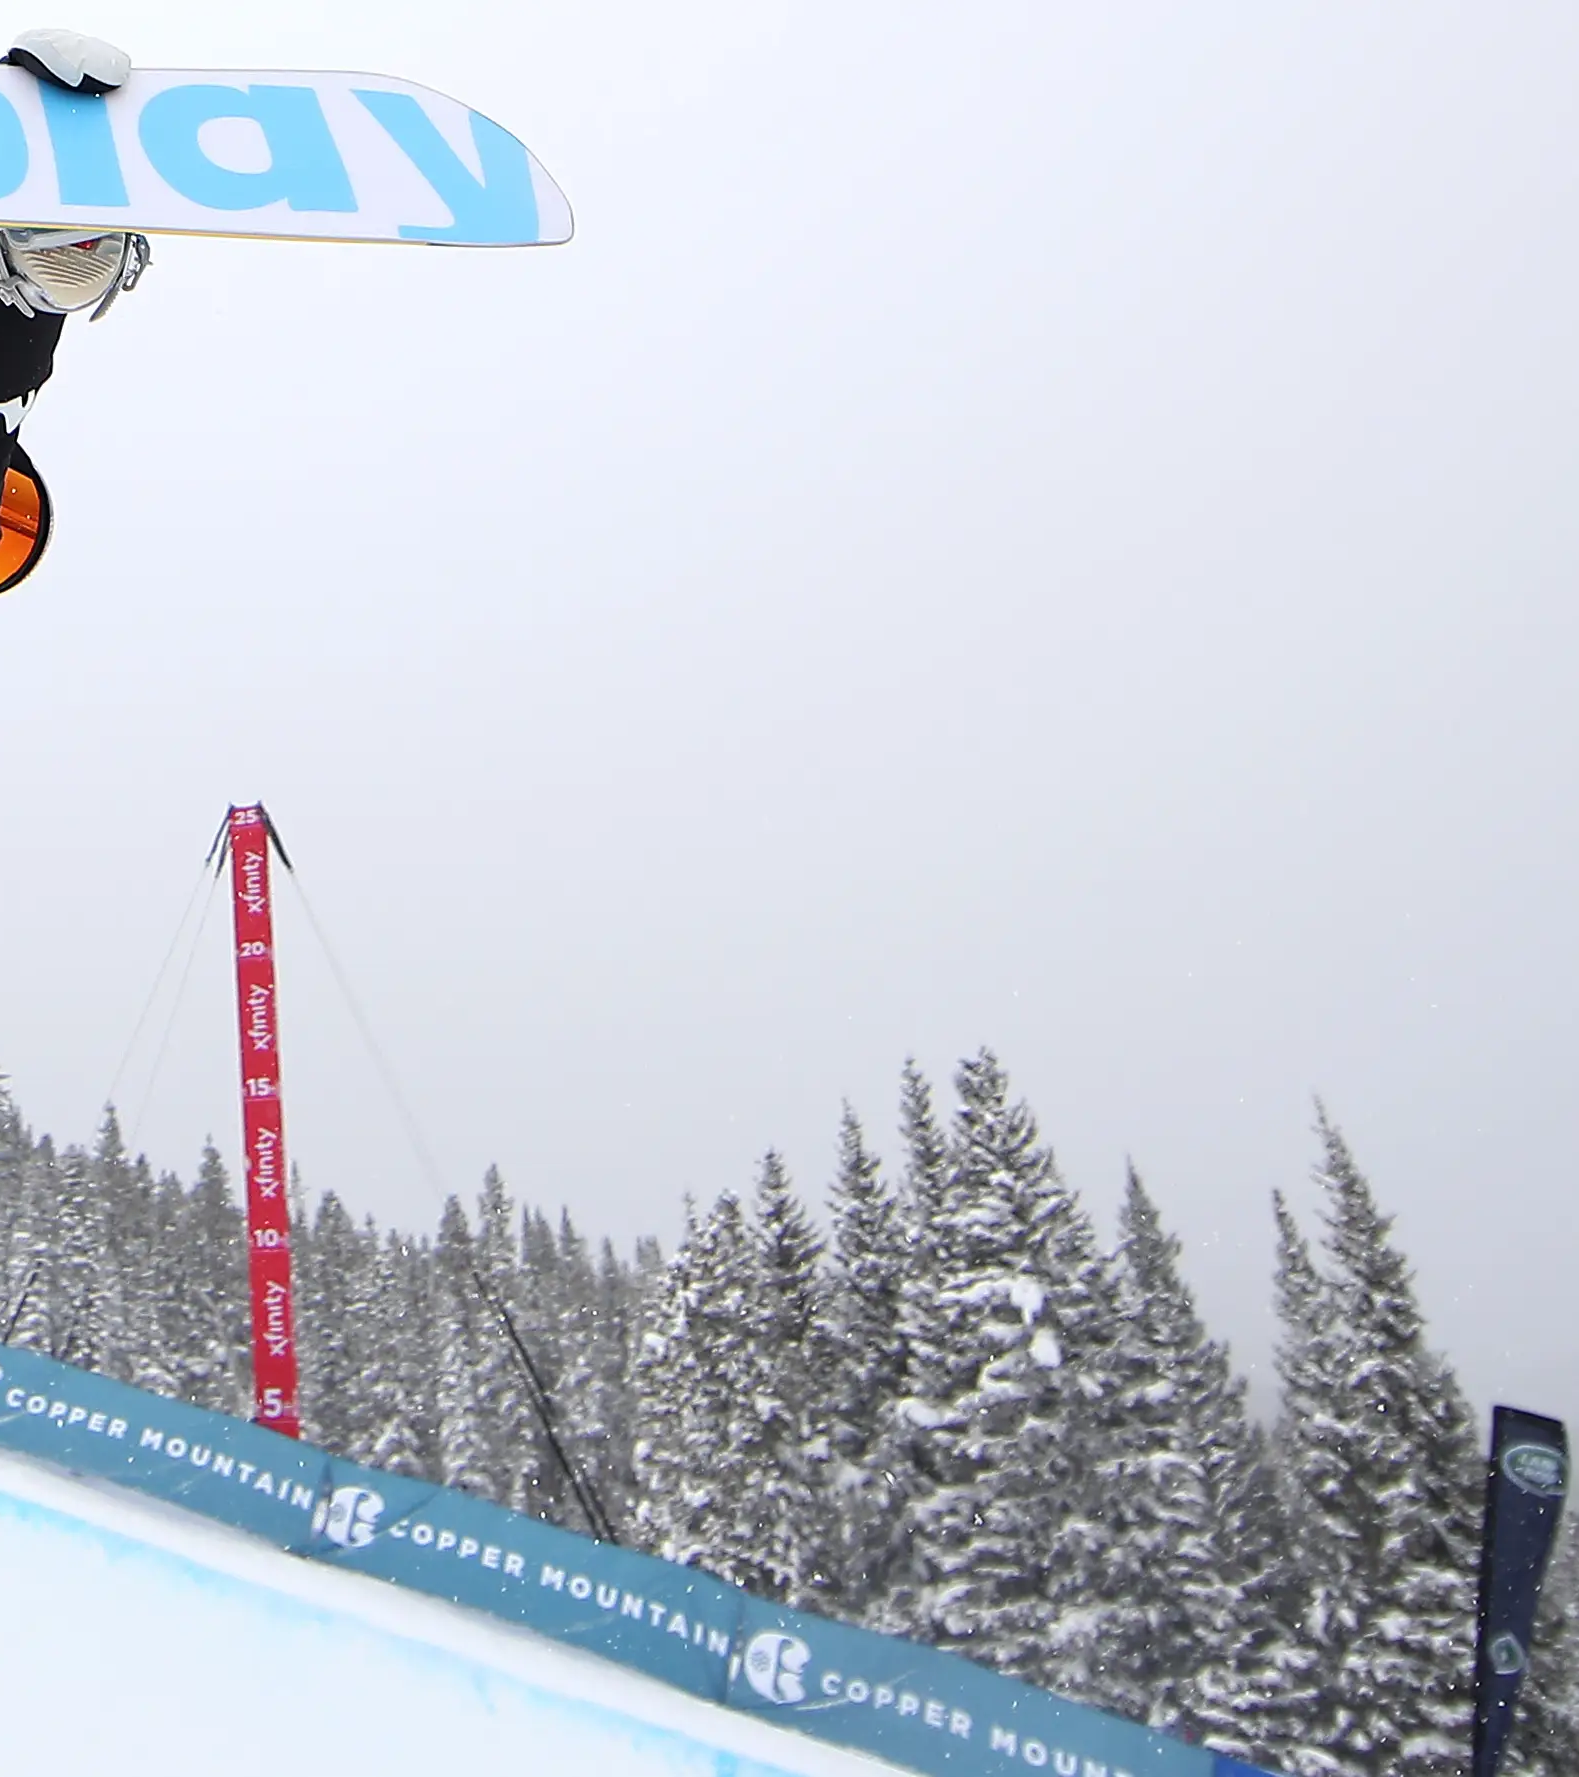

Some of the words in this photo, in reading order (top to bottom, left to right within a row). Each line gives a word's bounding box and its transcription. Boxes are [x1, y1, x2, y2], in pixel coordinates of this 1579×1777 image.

[234, 809, 258, 825] 25
[241, 850, 264, 913] xfinity
[240, 941, 265, 957] 20
[247, 983, 272, 1051] xfinity
[245, 1077, 271, 1096] 15
[253, 1127, 279, 1198] xfinity
[253, 1229, 280, 1248] 10
[263, 1280, 288, 1357] xfinity
[263, 1388, 283, 1418] 5
[5, 1387, 129, 1439] COPPER
[139, 1427, 315, 1510] MOUNTAIN
[388, 1518, 526, 1577] COPPER
[540, 1564, 729, 1657] MOUNTAIN
[821, 1670, 972, 1740] COPPER
